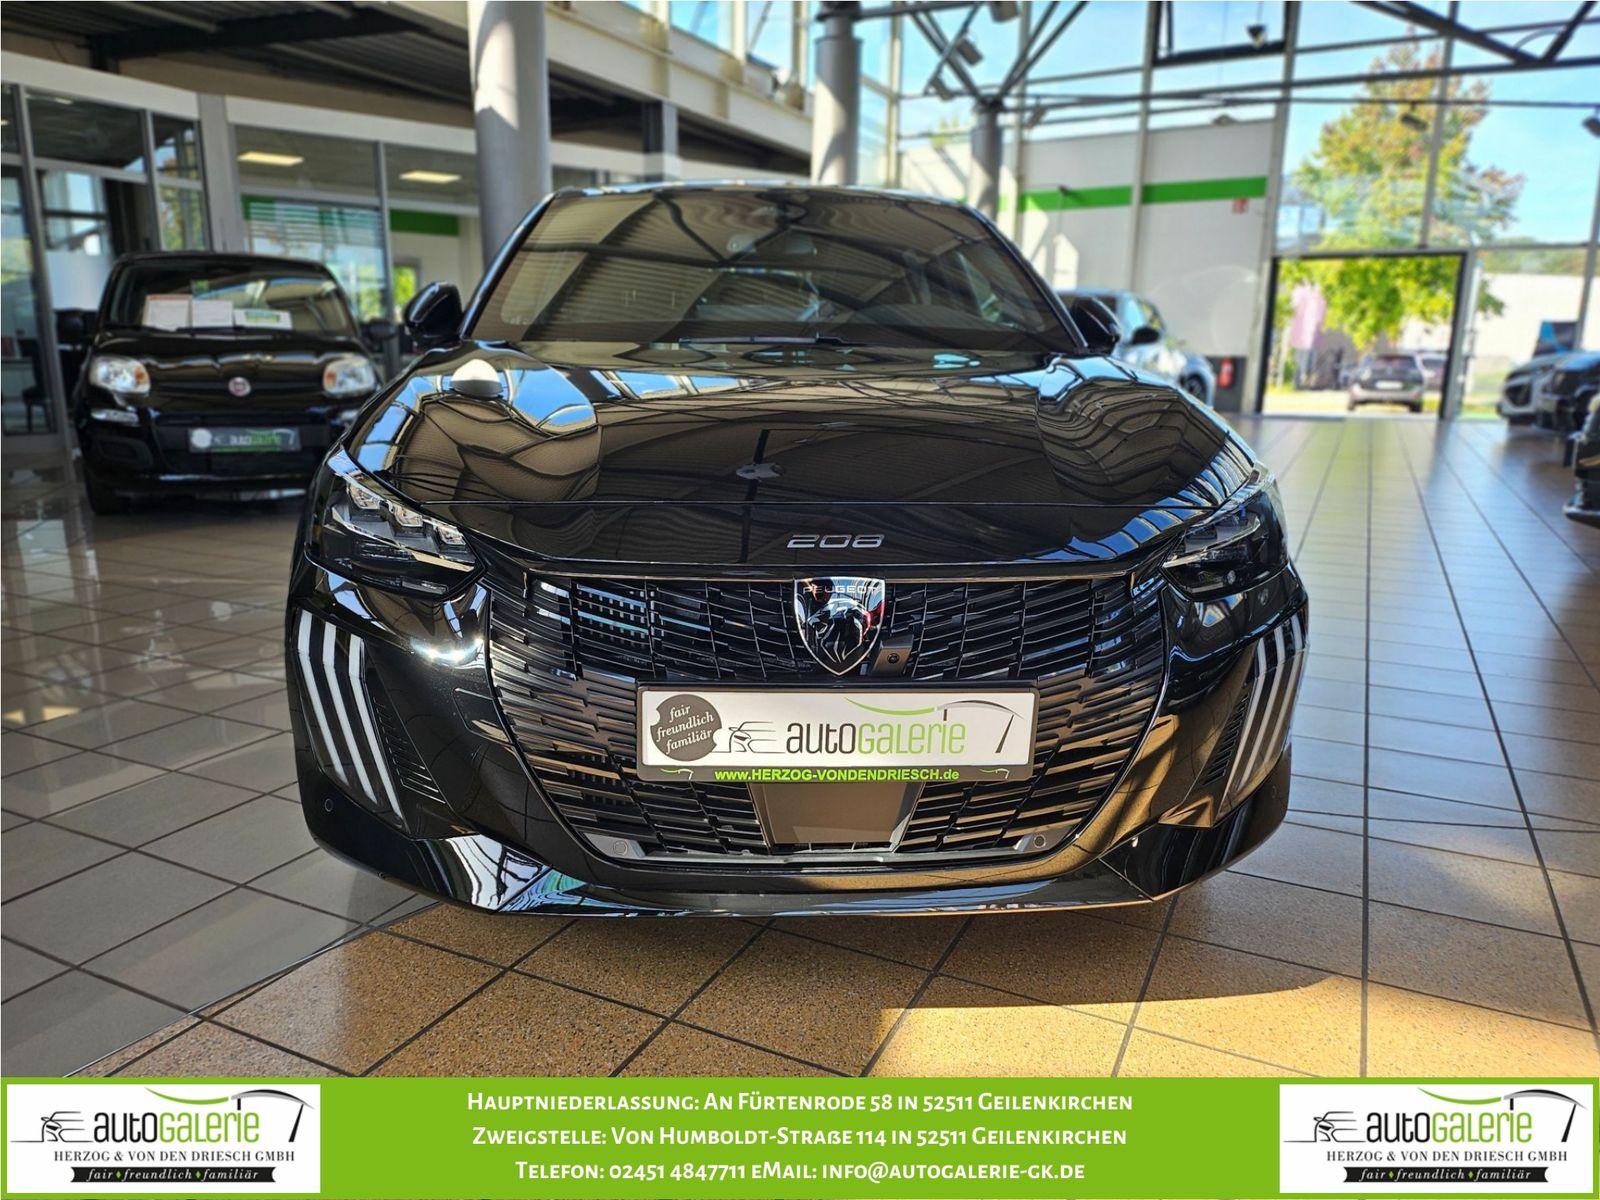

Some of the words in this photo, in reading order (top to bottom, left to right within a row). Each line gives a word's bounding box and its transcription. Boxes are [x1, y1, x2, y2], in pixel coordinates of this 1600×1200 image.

[787, 534, 885, 548] 208
[803, 585, 877, 594] PEUGEOT
[669, 704, 691, 723] fair
[656, 711, 714, 742] freundlich
[666, 729, 712, 755] familiär
[714, 768, 960, 781] www.HERZOG-VONDENDRIESCH.de
